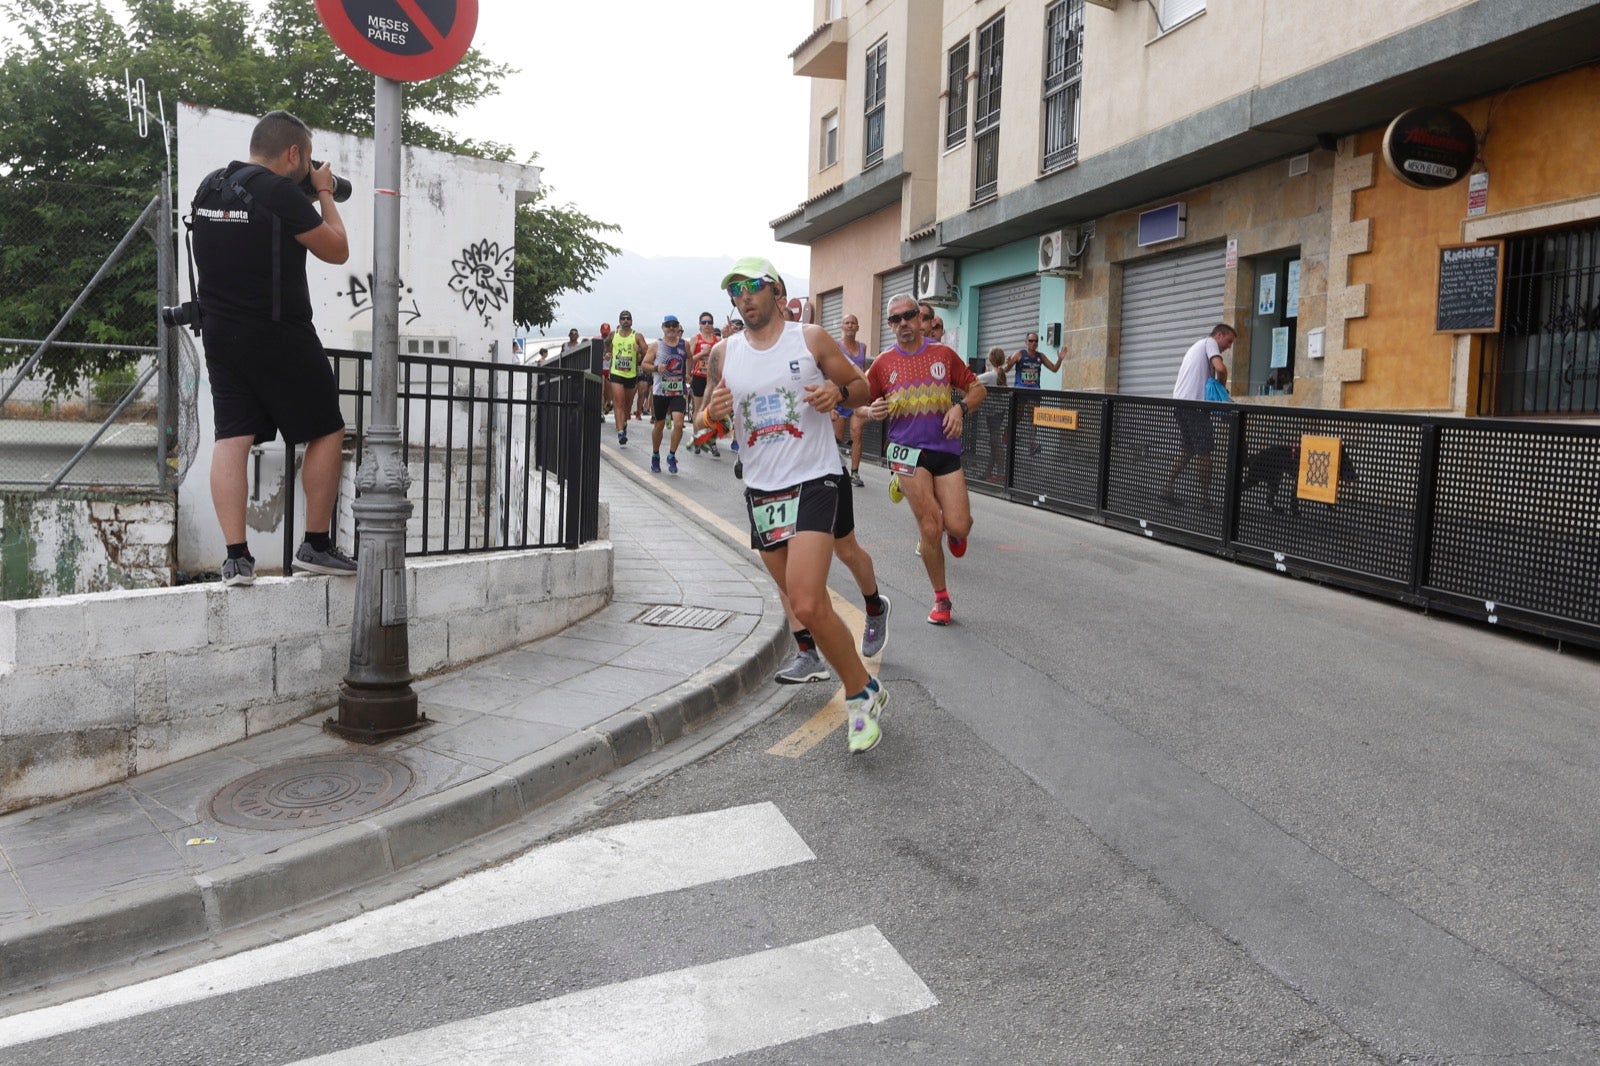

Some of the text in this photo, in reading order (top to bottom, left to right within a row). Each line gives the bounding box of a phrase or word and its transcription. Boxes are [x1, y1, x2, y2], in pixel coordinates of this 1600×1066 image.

[368, 15, 409, 33] MESES
[368, 28, 406, 45] PARES
[755, 394, 781, 413] 25
[893, 446, 909, 461] 80
[766, 503, 786, 525] 21
